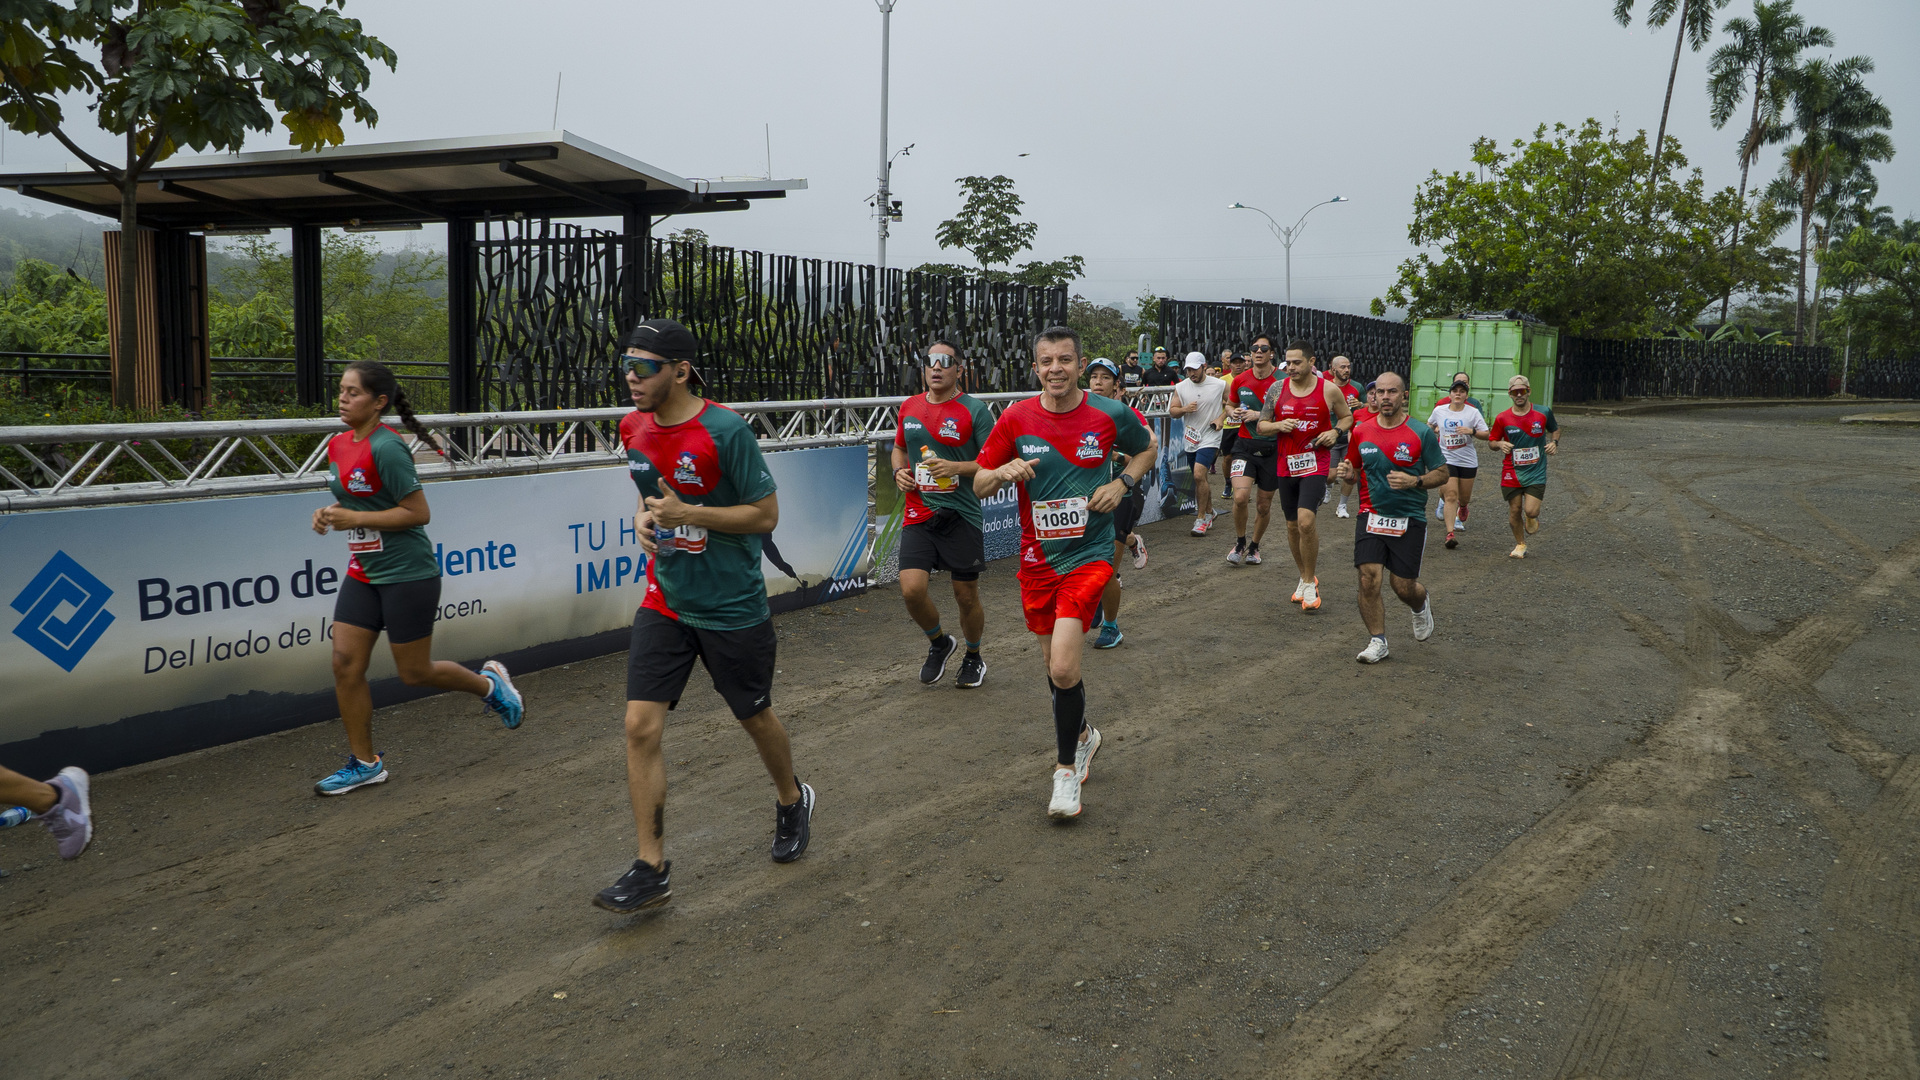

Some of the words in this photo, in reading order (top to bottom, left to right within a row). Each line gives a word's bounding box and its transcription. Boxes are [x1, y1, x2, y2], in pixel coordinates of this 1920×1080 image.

[1290, 460, 1310, 470] 1857
[982, 516, 1002, 533] lado
[1002, 514, 1014, 529] de
[1041, 511, 1080, 528] 1080
[1377, 518, 1398, 528] 418
[568, 520, 606, 553] TU
[138, 574, 280, 621] Banco
[290, 559, 338, 599] de
[433, 541, 517, 577] dente
[576, 552, 648, 594] IMPA
[828, 576, 865, 594] AVAL
[144, 638, 195, 674] Del
[206, 629, 271, 664] lado
[278, 621, 312, 649] de
[433, 598, 487, 622] acen.
